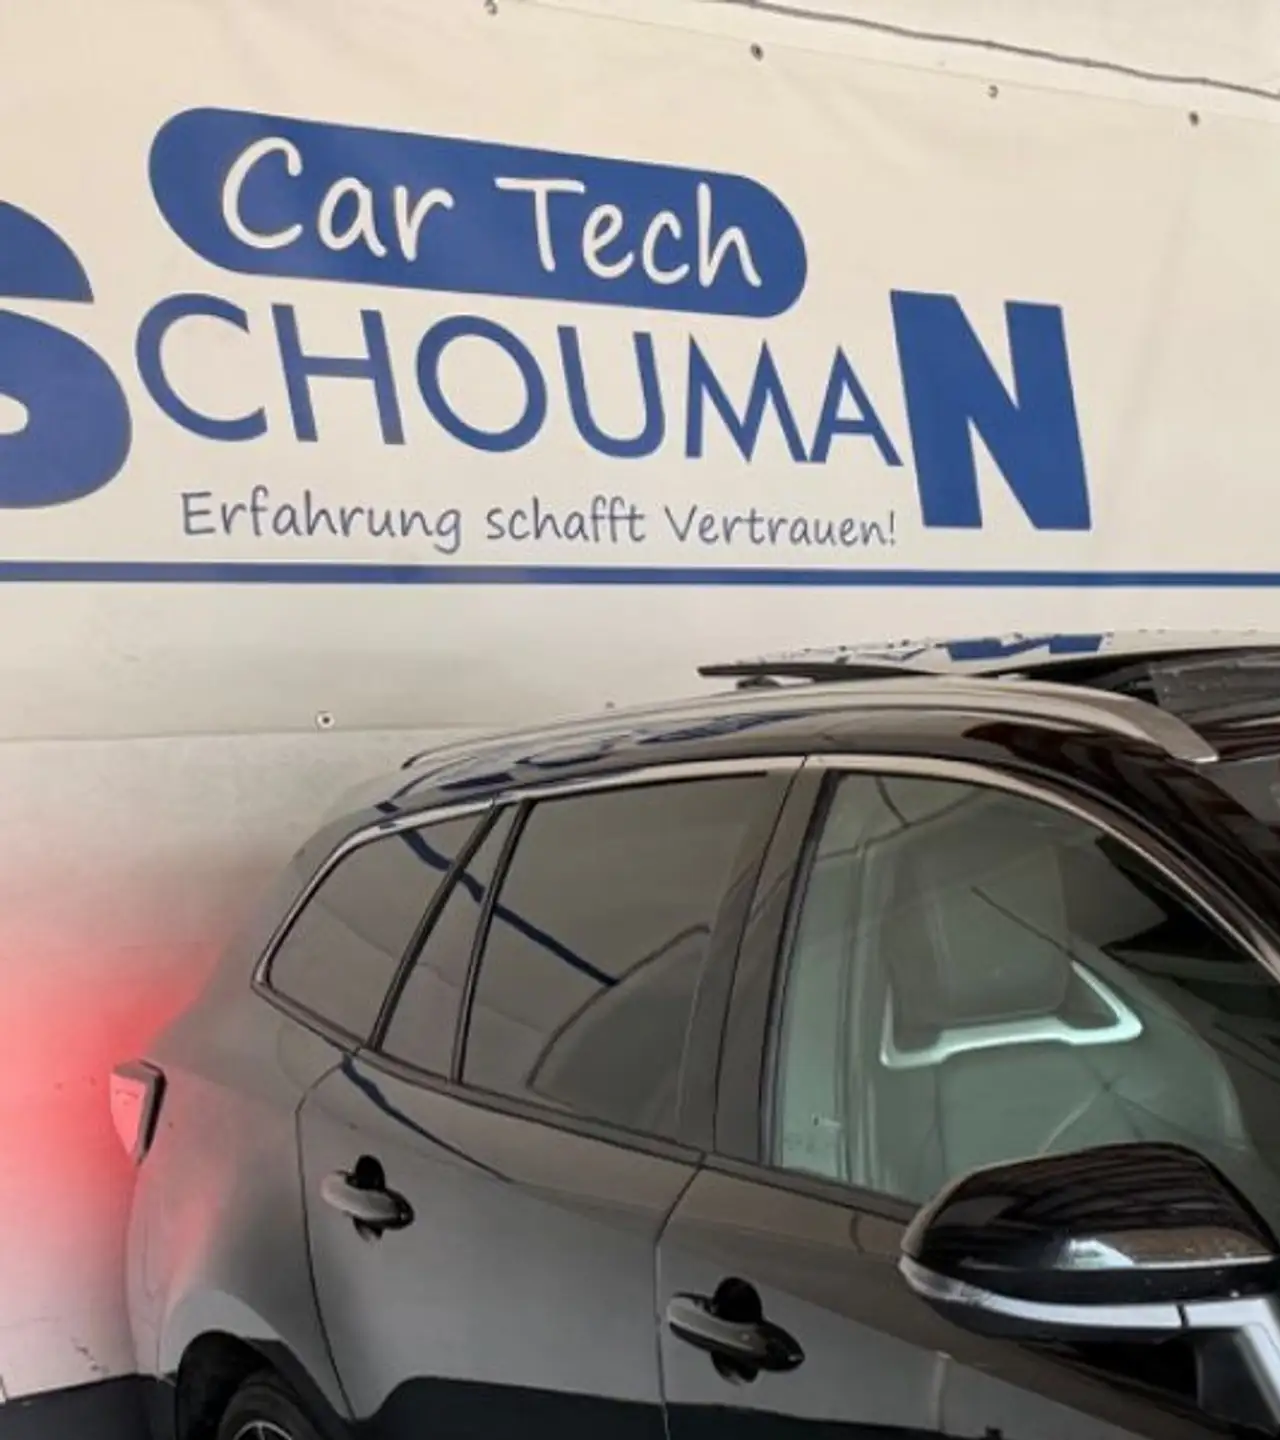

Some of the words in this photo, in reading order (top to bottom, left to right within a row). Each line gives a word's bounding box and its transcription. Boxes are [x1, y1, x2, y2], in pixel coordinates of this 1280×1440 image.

[221, 135, 454, 263] Car
[493, 175, 763, 288] Tech
[180, 486, 463, 555] Erfahrung
[486, 496, 648, 544] schafft
[664, 503, 897, 548] Vertrauen!
